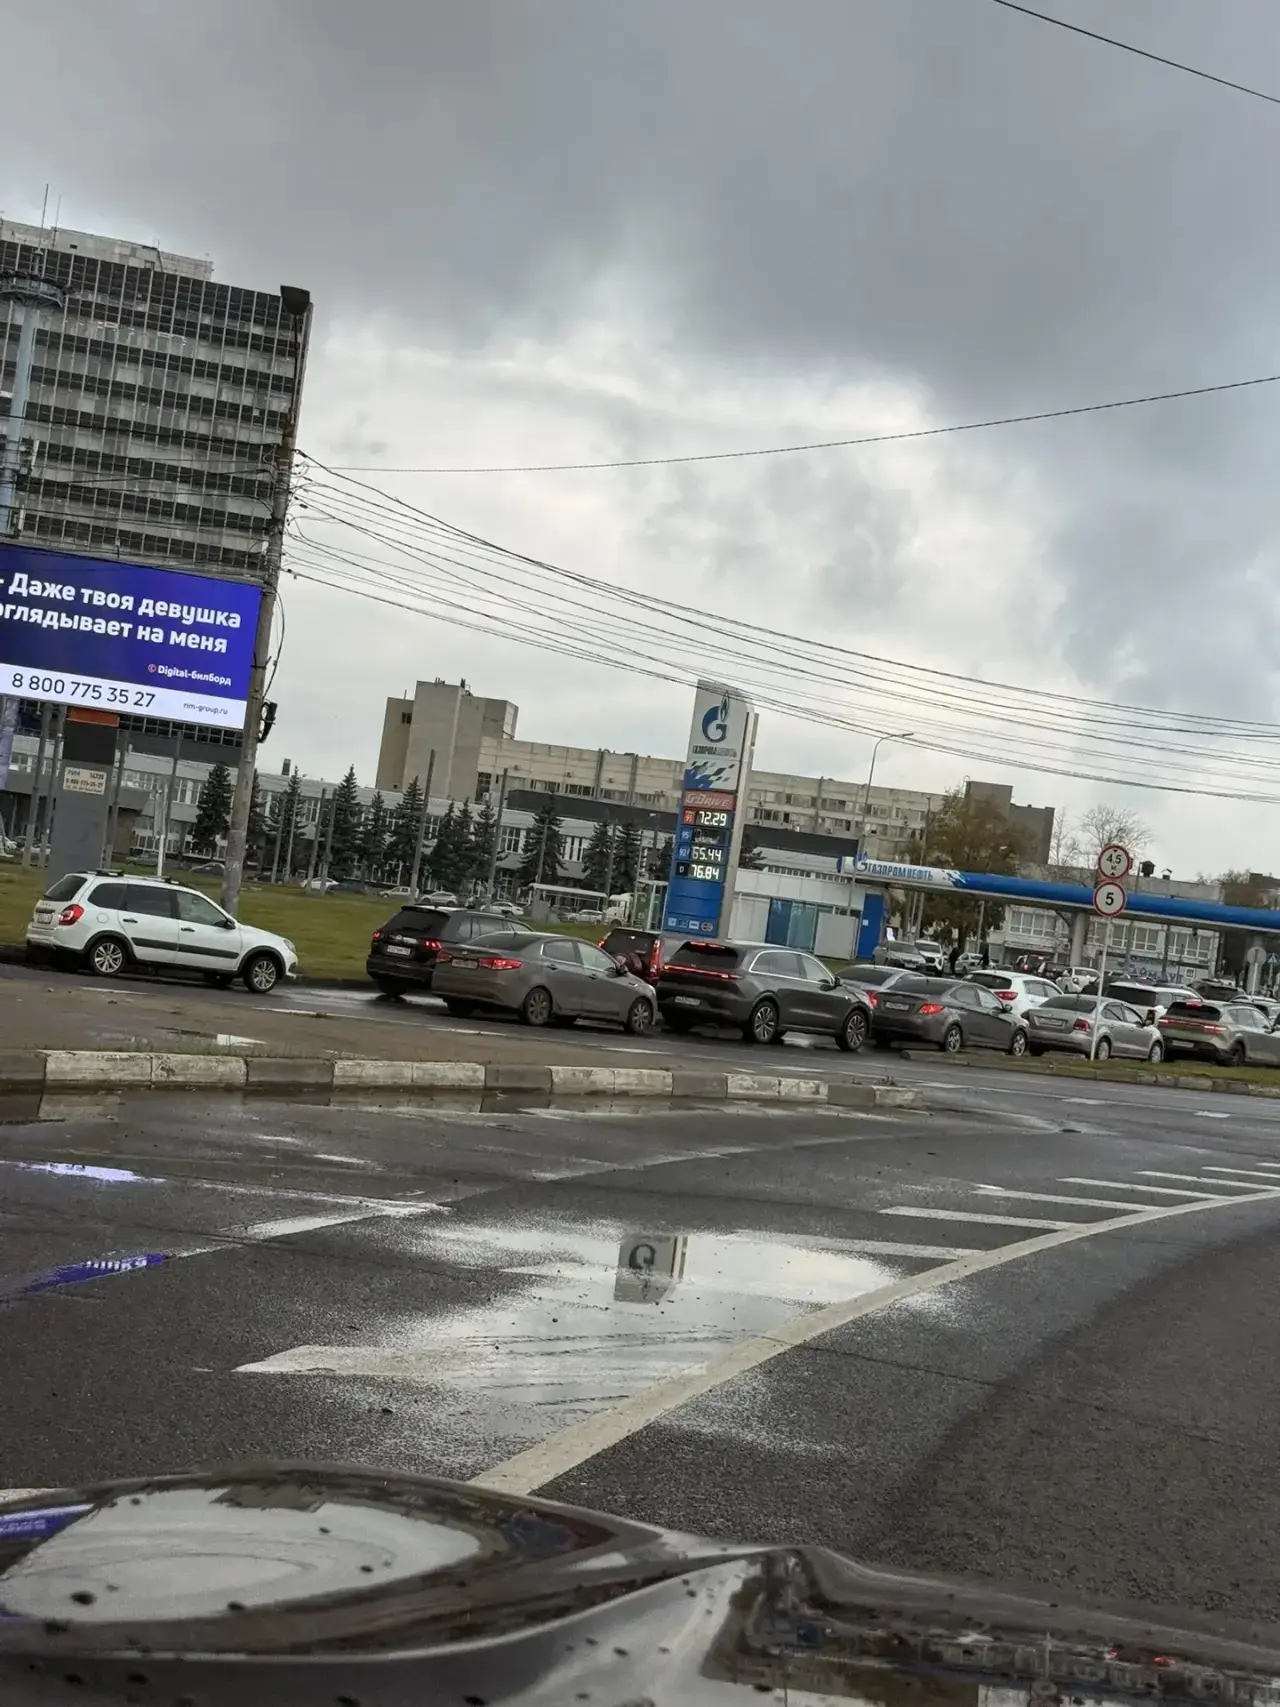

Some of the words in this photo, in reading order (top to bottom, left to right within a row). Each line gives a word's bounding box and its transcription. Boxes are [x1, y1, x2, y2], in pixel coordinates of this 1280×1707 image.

[8, 572, 75, 601] Даже
[80, 587, 134, 611] твоя
[138, 599, 241, 629] девушка
[137, 624, 164, 643] на
[169, 630, 228, 654] меня
[158, 664, 231, 686] Digital-билборд
[12, 672, 23, 688] 8
[29, 675, 65, 694] 800
[70, 681, 102, 700] 775
[107, 686, 129, 704] 35
[133, 691, 156, 708] 27
[183, 702, 228, 715] rim-group.ru
[698, 810, 727, 826] 72.29
[692, 846, 722, 861] 65.44
[691, 864, 720, 880] 76.84
[867, 860, 933, 881] ГАЗПРОМНЕФТЬ
[1105, 892, 1115, 906] 5
